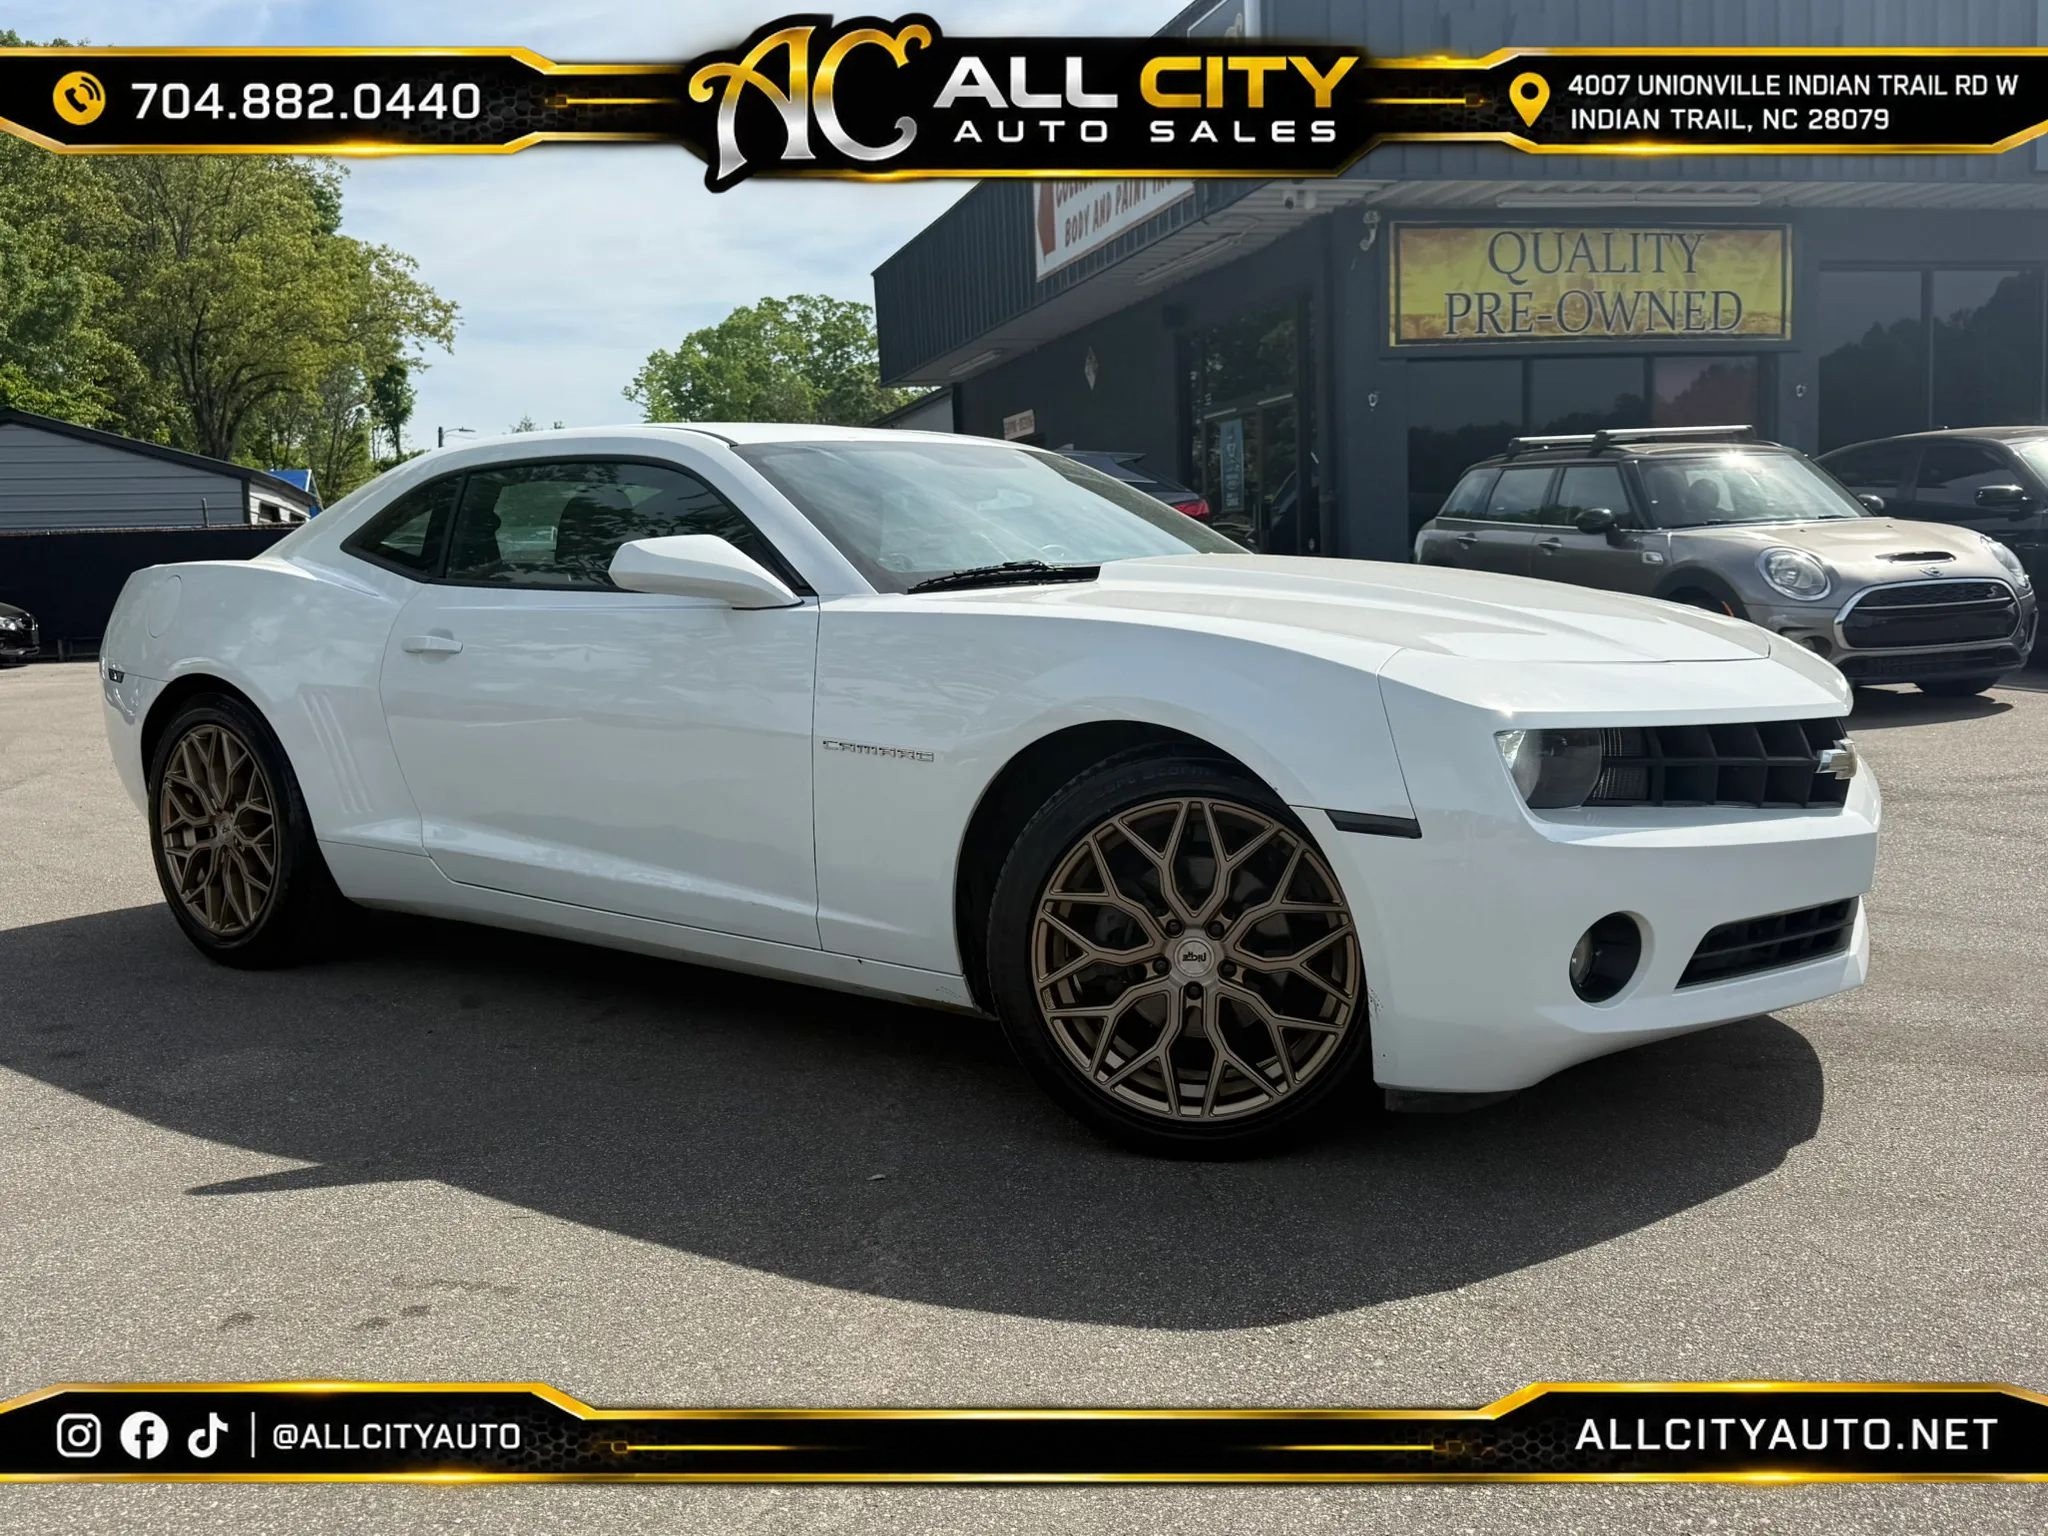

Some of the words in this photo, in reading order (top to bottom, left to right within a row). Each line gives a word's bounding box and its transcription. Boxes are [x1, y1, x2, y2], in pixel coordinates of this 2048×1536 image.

[1065, 204, 1090, 247] BODY
[1092, 191, 1112, 233] AND
[1487, 230, 1706, 285] QUALITY
[1444, 289, 1743, 335] PRE-OWNED
